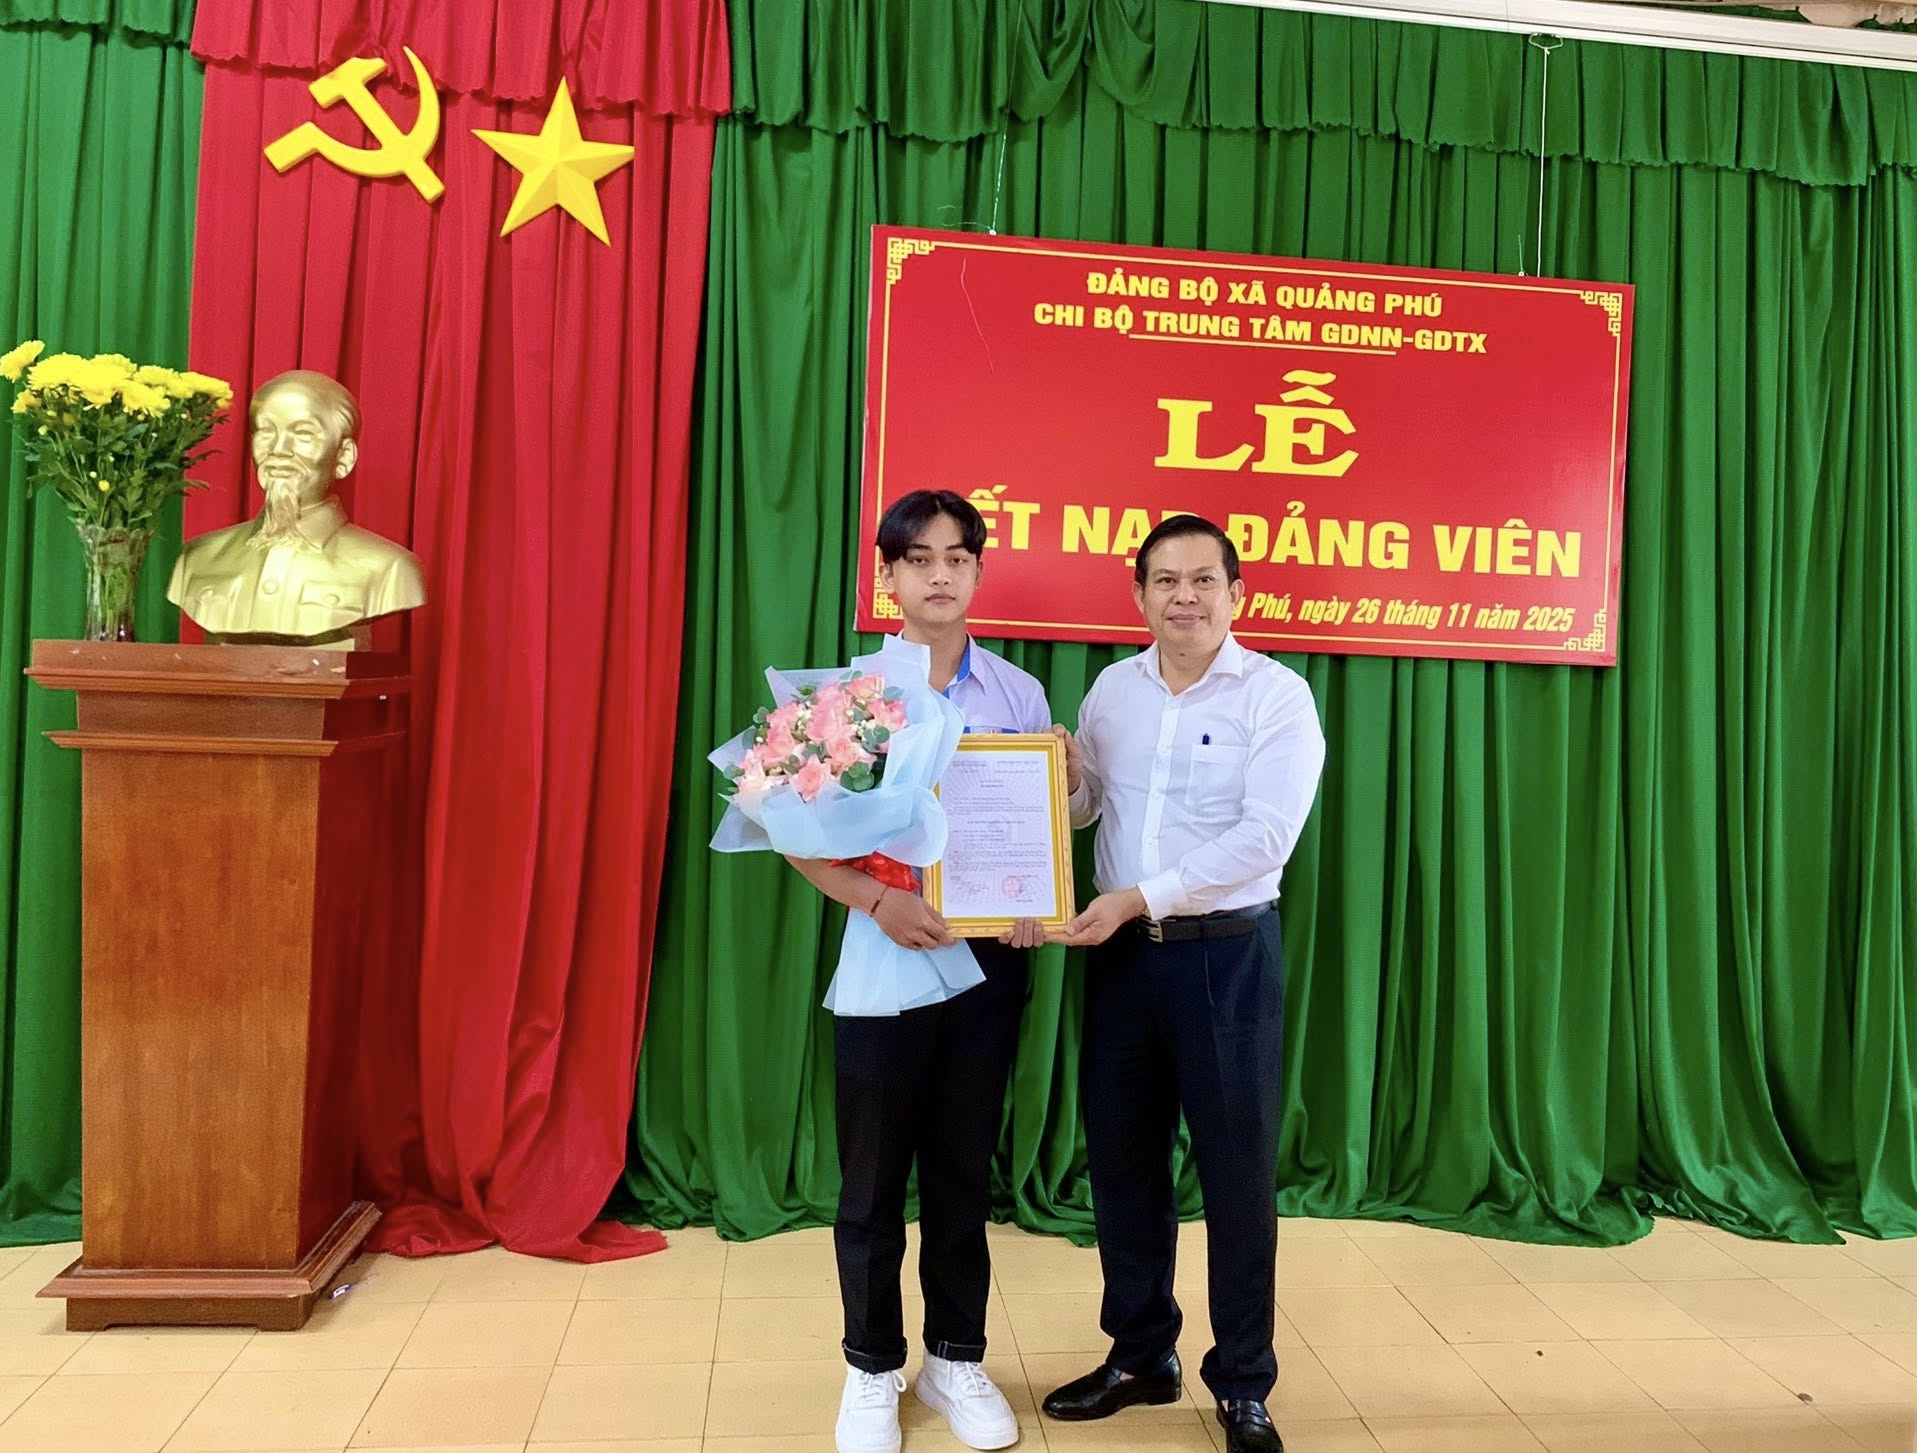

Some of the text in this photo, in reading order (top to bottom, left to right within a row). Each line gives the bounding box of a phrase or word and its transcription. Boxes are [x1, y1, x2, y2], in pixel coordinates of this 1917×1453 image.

[1086, 267, 1442, 318] ĐẢNG BỘ XÃ QUẢNG PHÚ
[1033, 303, 1488, 354] CHI BỘ TRUNG TÂM GDNN-GDTX
[1154, 369, 1360, 478] LỄ
[1061, 504, 1200, 568] NẠ
[1223, 501, 1410, 571] ĐẢNG
[1431, 519, 1582, 579] VIÊN
[1248, 592, 1292, 623] Phú,
[1299, 595, 1351, 626] ngày
[1352, 597, 1382, 624] 26
[1383, 599, 1442, 630] tháng
[1446, 602, 1472, 628] 11
[1474, 603, 1521, 631] năm
[1522, 605, 1577, 633] 2025
